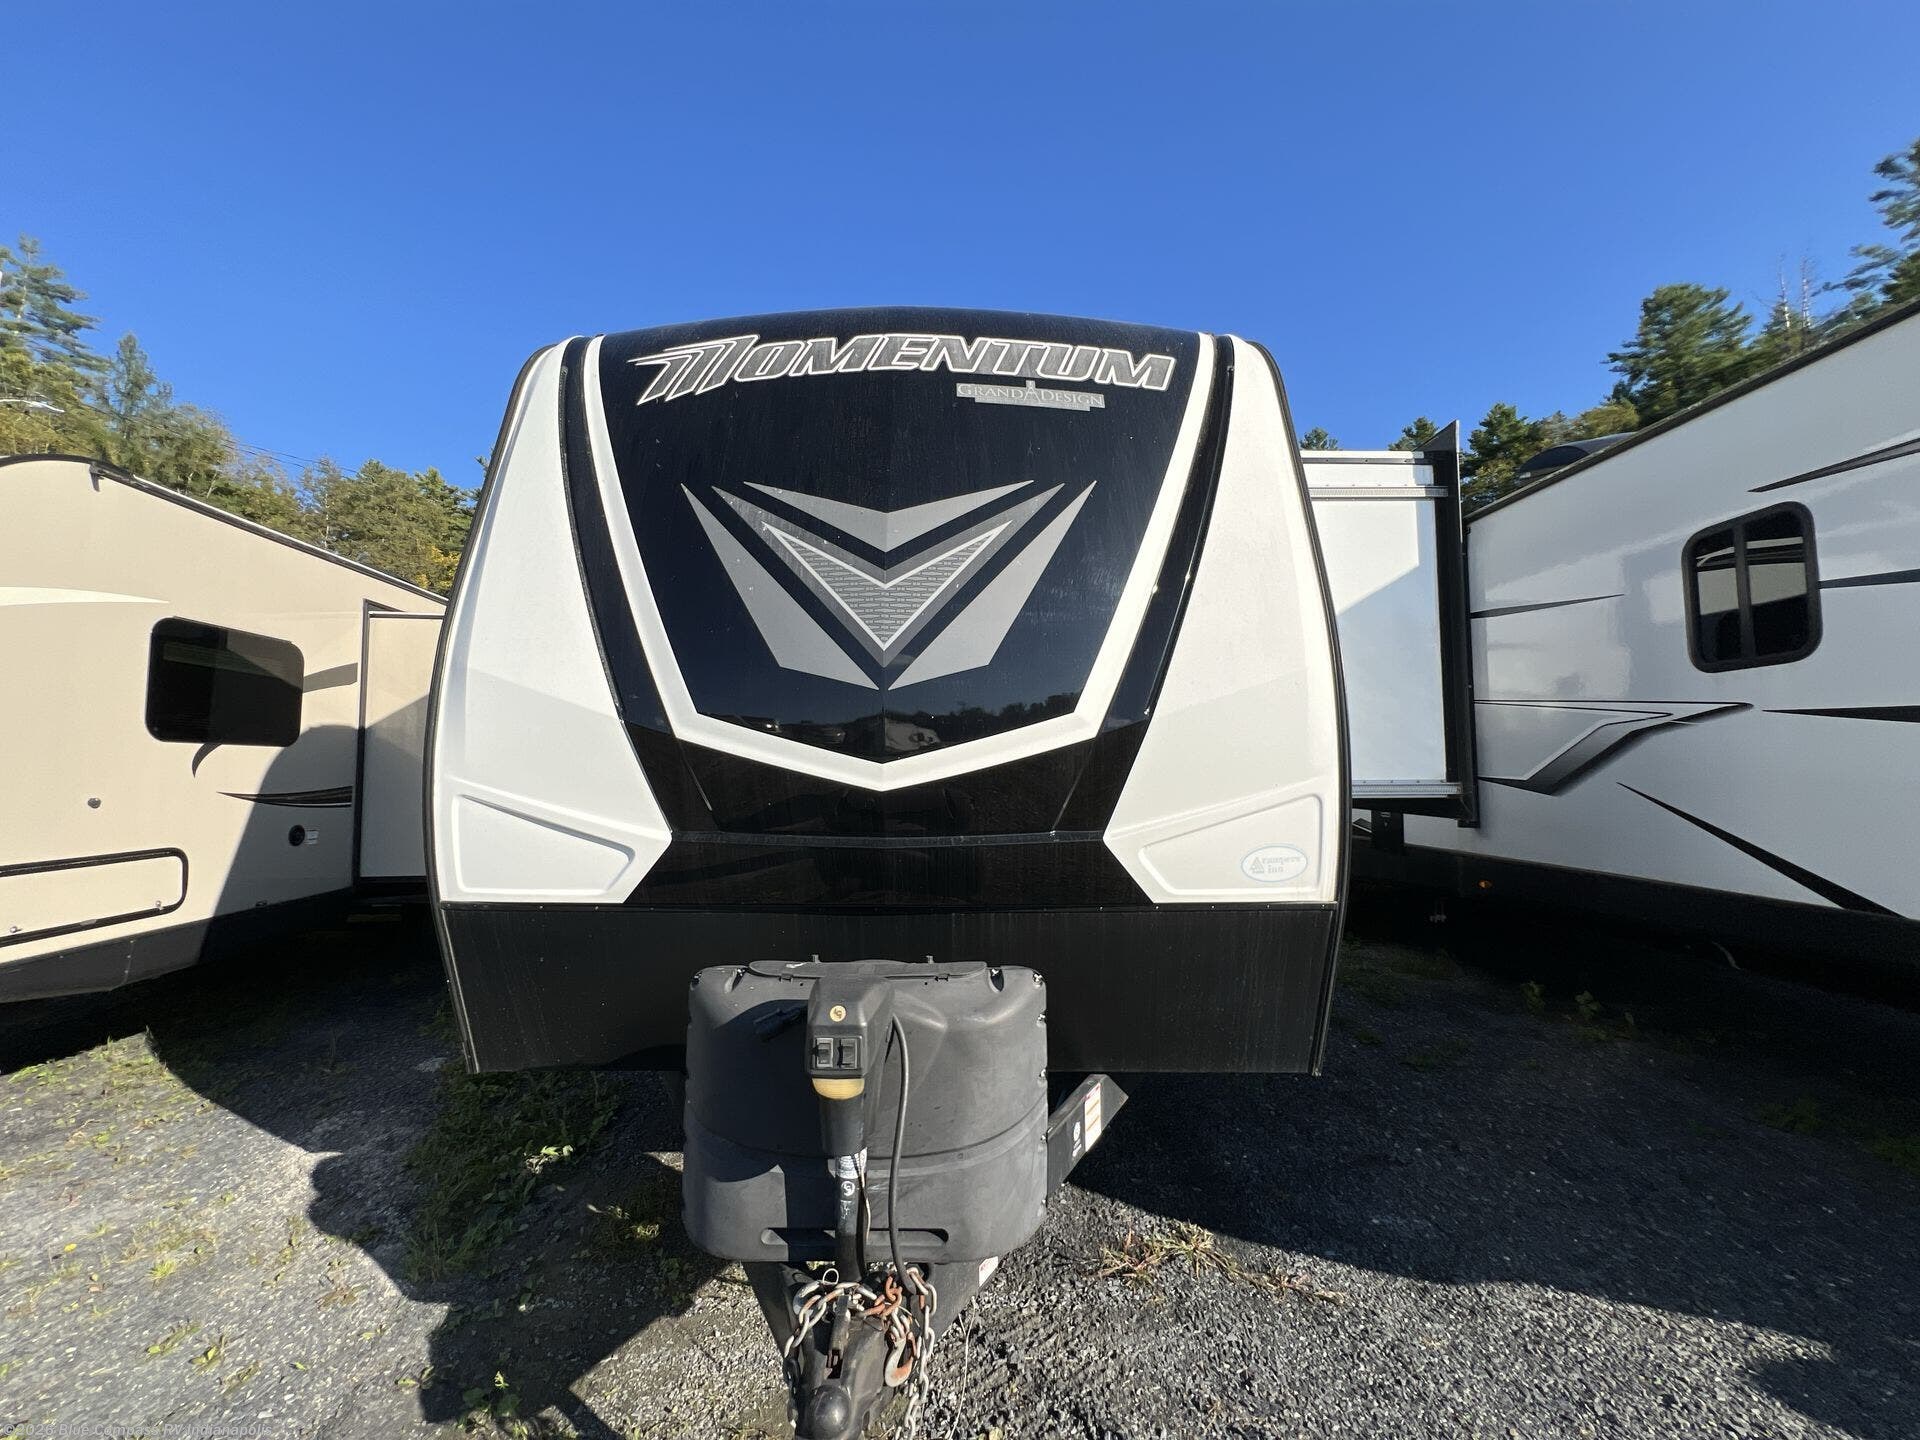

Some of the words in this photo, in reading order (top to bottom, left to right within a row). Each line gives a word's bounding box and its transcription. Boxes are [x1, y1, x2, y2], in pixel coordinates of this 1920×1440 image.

[628, 333, 1176, 405] MOMENTUM
[957, 384, 1024, 399] GRAND
[1041, 388, 1103, 406] DESIGN
